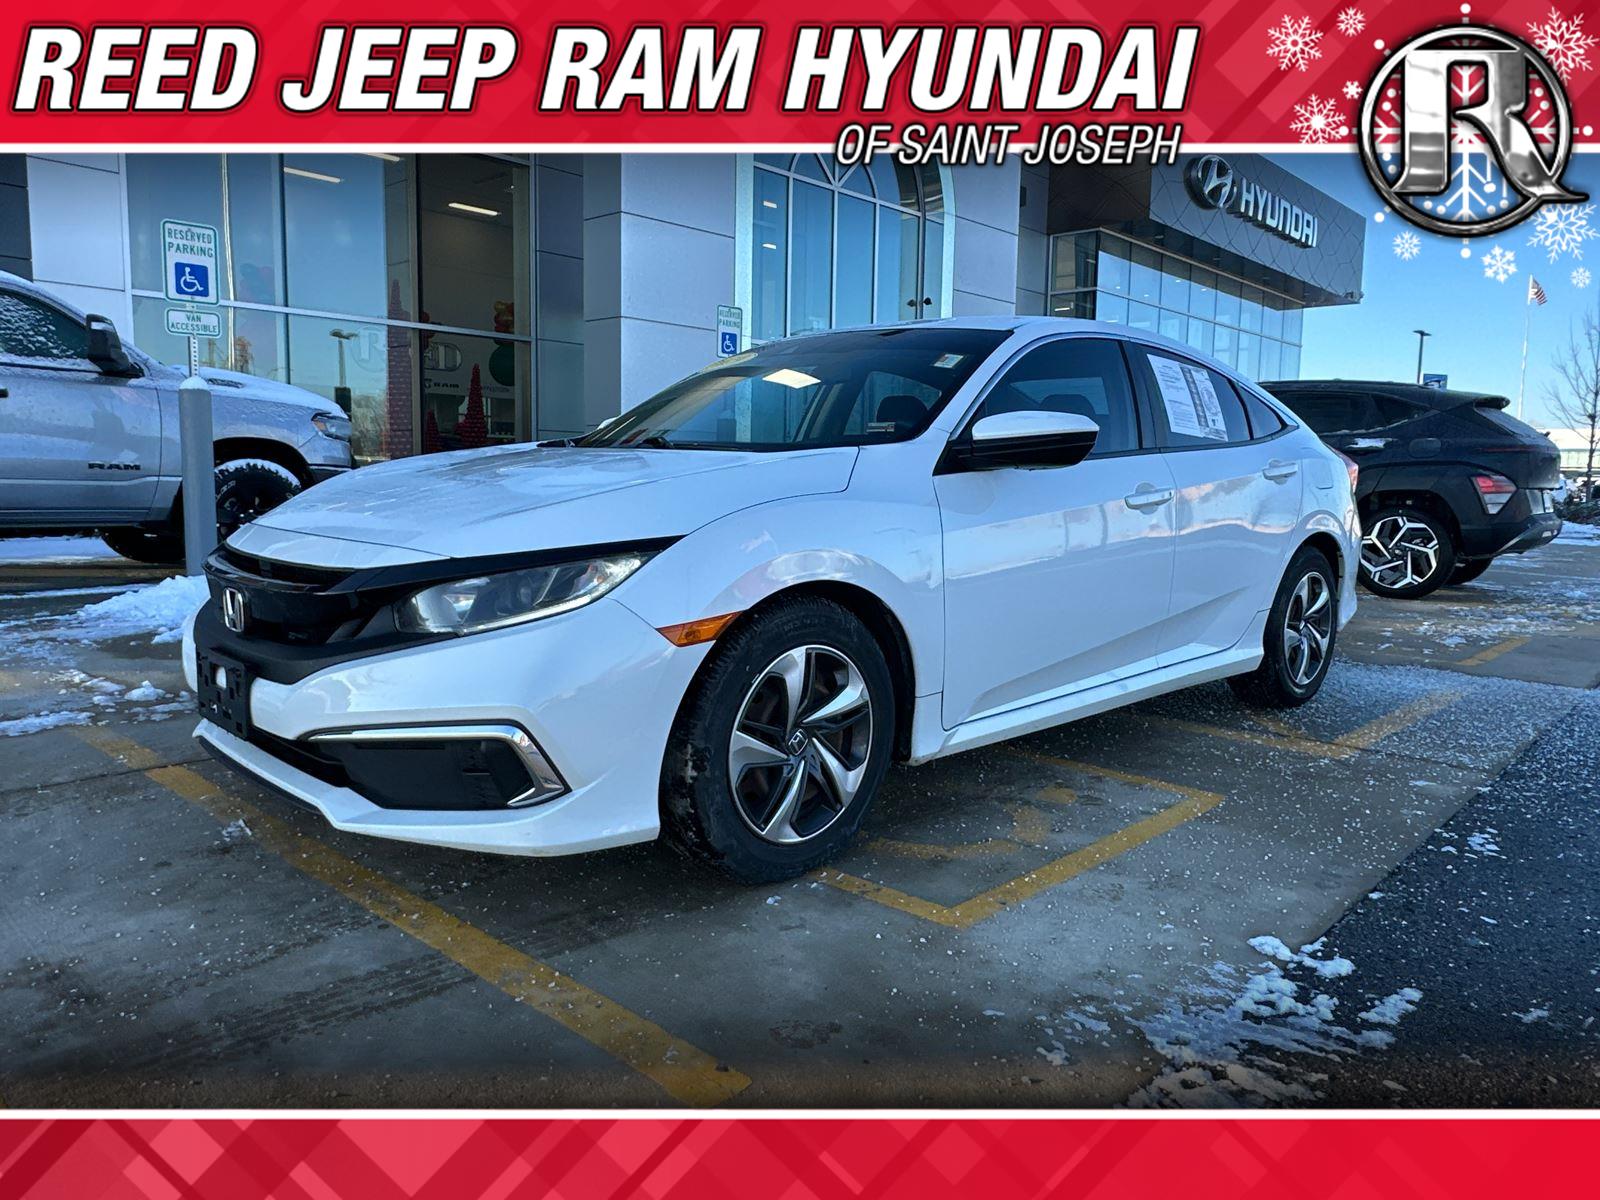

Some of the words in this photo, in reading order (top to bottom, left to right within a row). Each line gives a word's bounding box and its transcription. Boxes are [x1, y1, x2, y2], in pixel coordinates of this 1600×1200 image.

[1240, 176, 1318, 248] HYUNDAI
[167, 227, 213, 245] RESERVED
[167, 241, 214, 258] PARKING
[186, 313, 202, 323] VAN
[719, 318, 741, 329] PARKING
[170, 322, 217, 333] ACCESSIBLE
[88, 462, 141, 471] RAM
